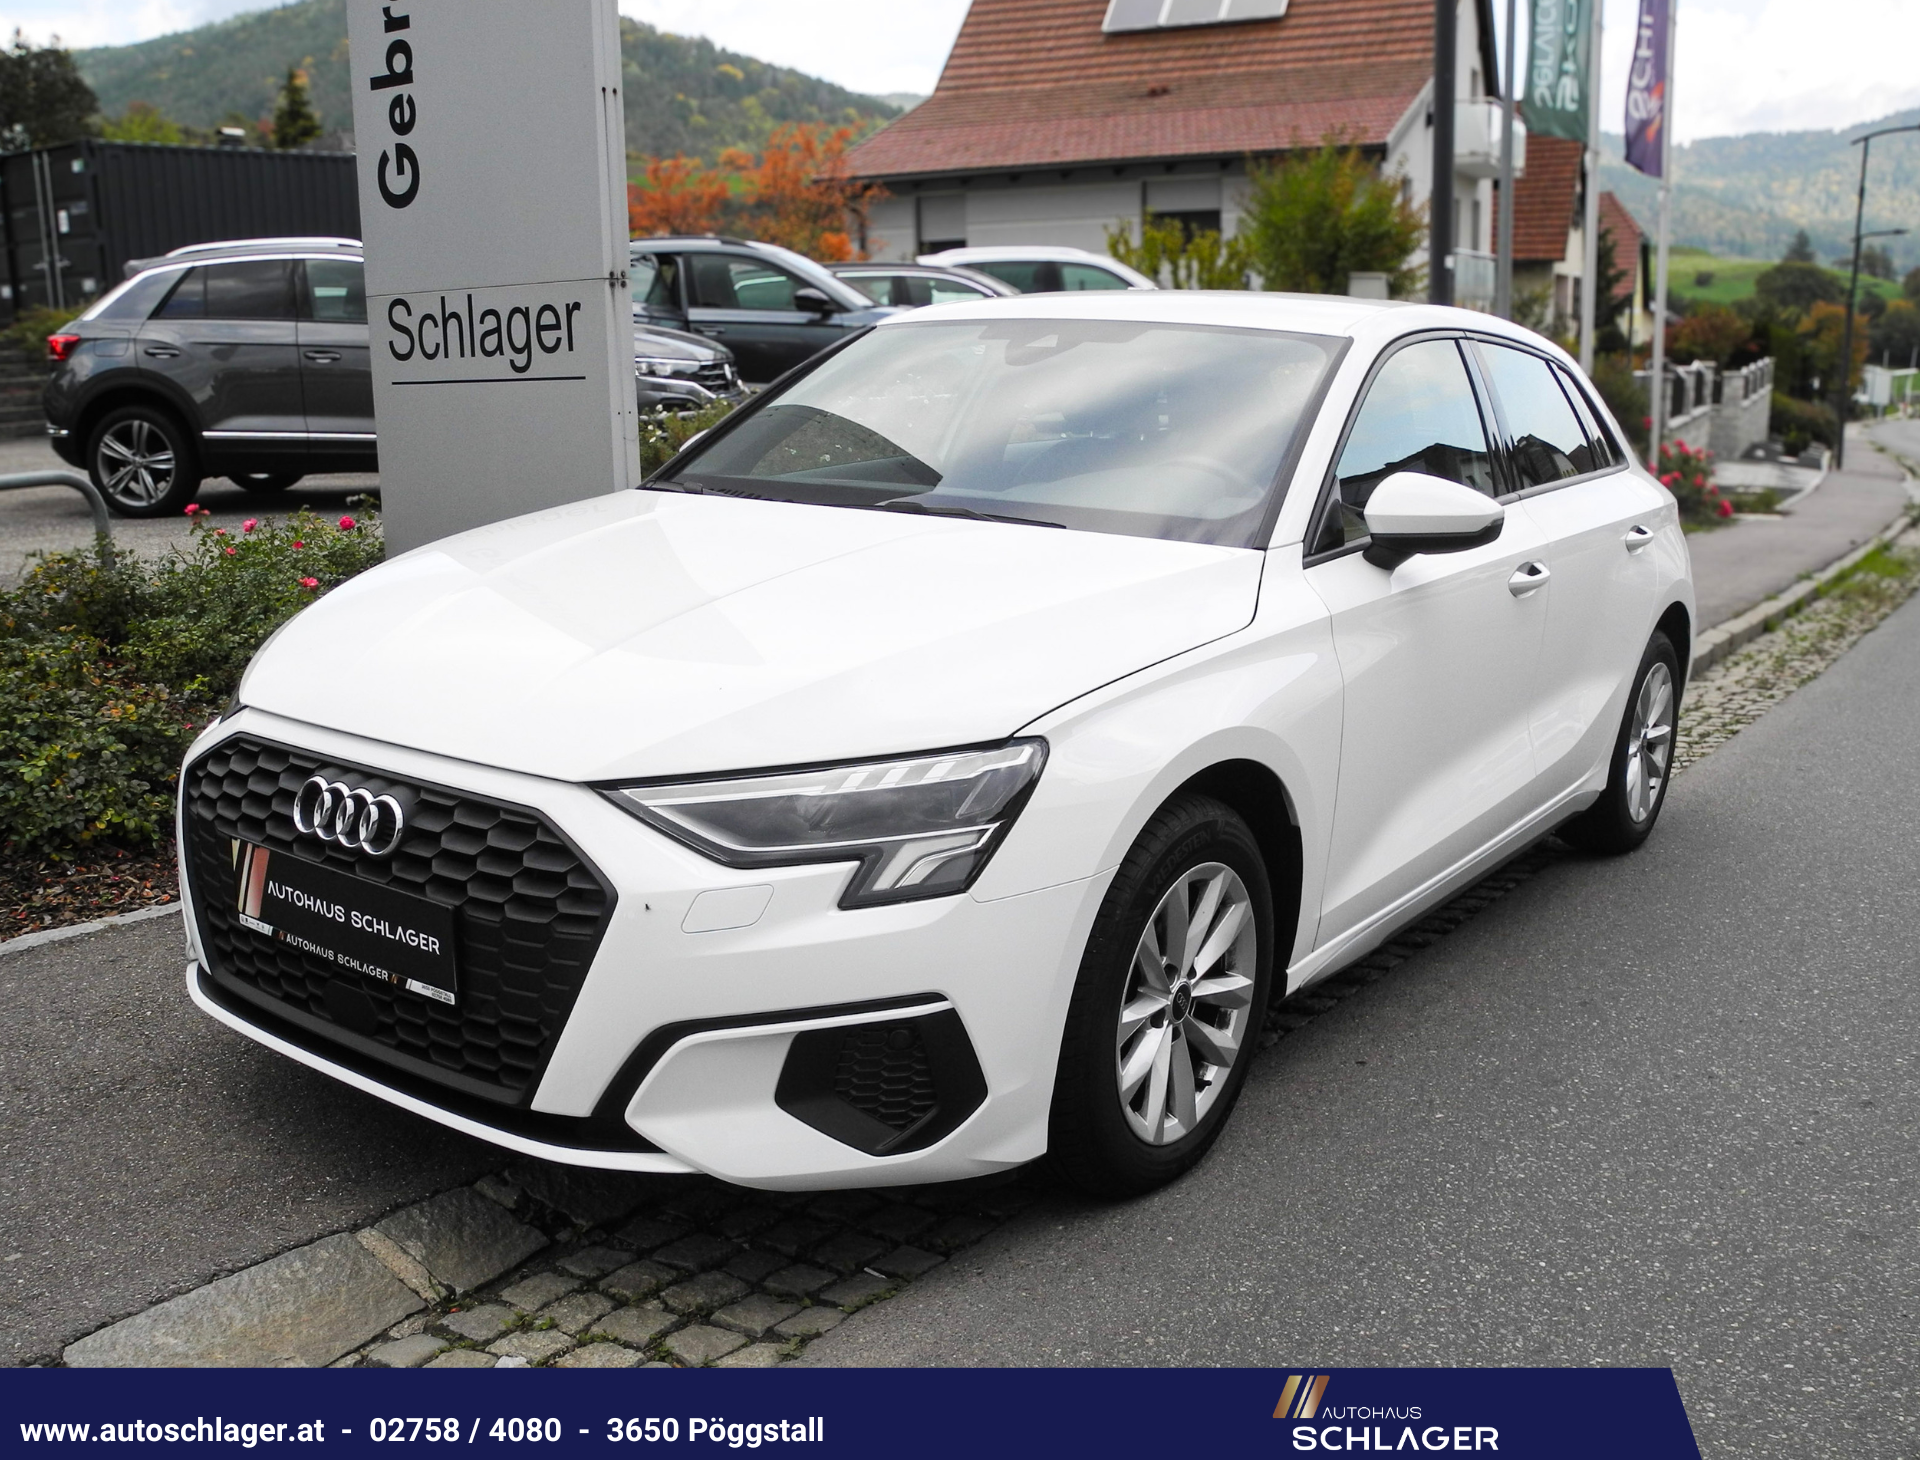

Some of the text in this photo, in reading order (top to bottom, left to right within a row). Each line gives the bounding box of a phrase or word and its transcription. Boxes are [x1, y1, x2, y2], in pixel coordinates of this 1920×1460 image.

[370, 5, 420, 209] Gebr
[387, 293, 582, 374] Schlager
[267, 880, 441, 955] AUTOHAUS SCHLAGER
[286, 933, 389, 982] AUTOHAUS SCHLAGER
